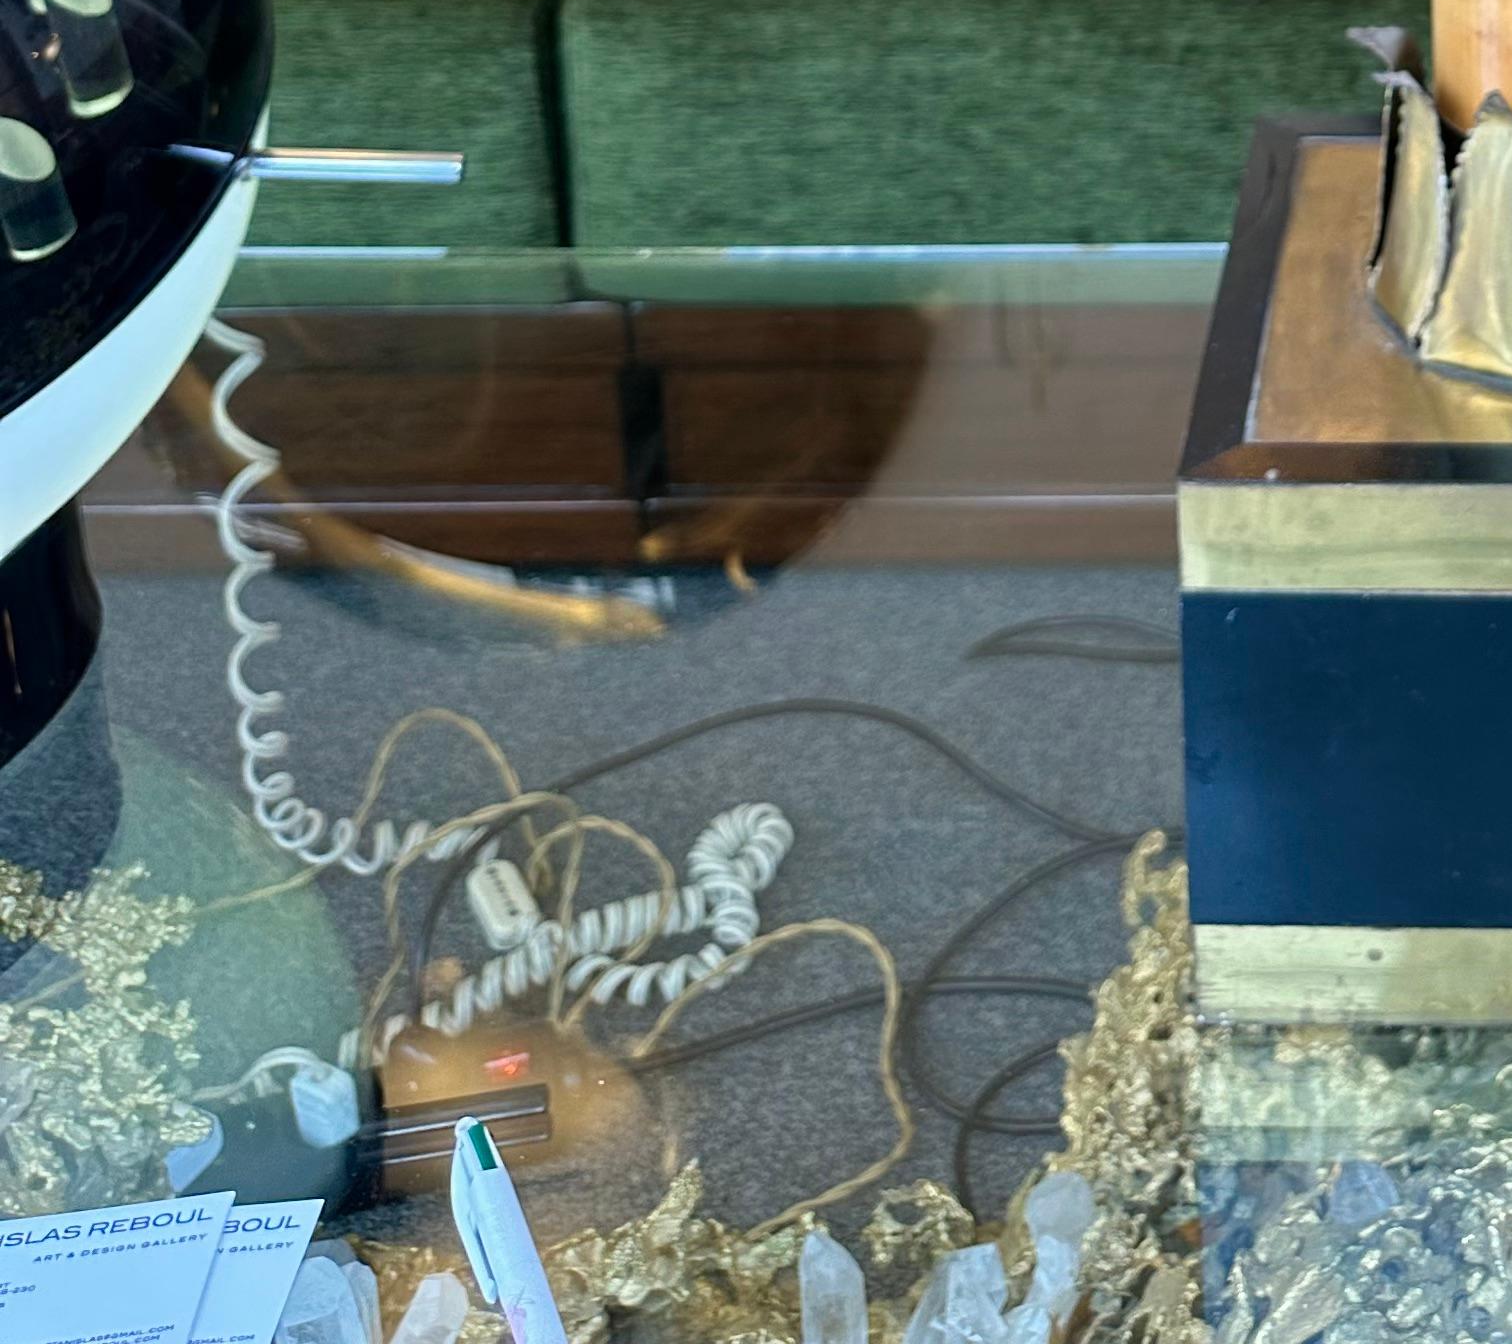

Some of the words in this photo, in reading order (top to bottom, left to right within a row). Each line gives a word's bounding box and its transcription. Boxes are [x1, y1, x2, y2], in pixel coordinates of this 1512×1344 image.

[0, 1224, 82, 1248] ISLAS
[88, 1207, 214, 1238] REBOUL
[33, 1252, 63, 1263] ART
[80, 1243, 137, 1258] DESIGN
[141, 1233, 209, 1249] GALLERY
[229, 1241, 295, 1254] GALLERY
